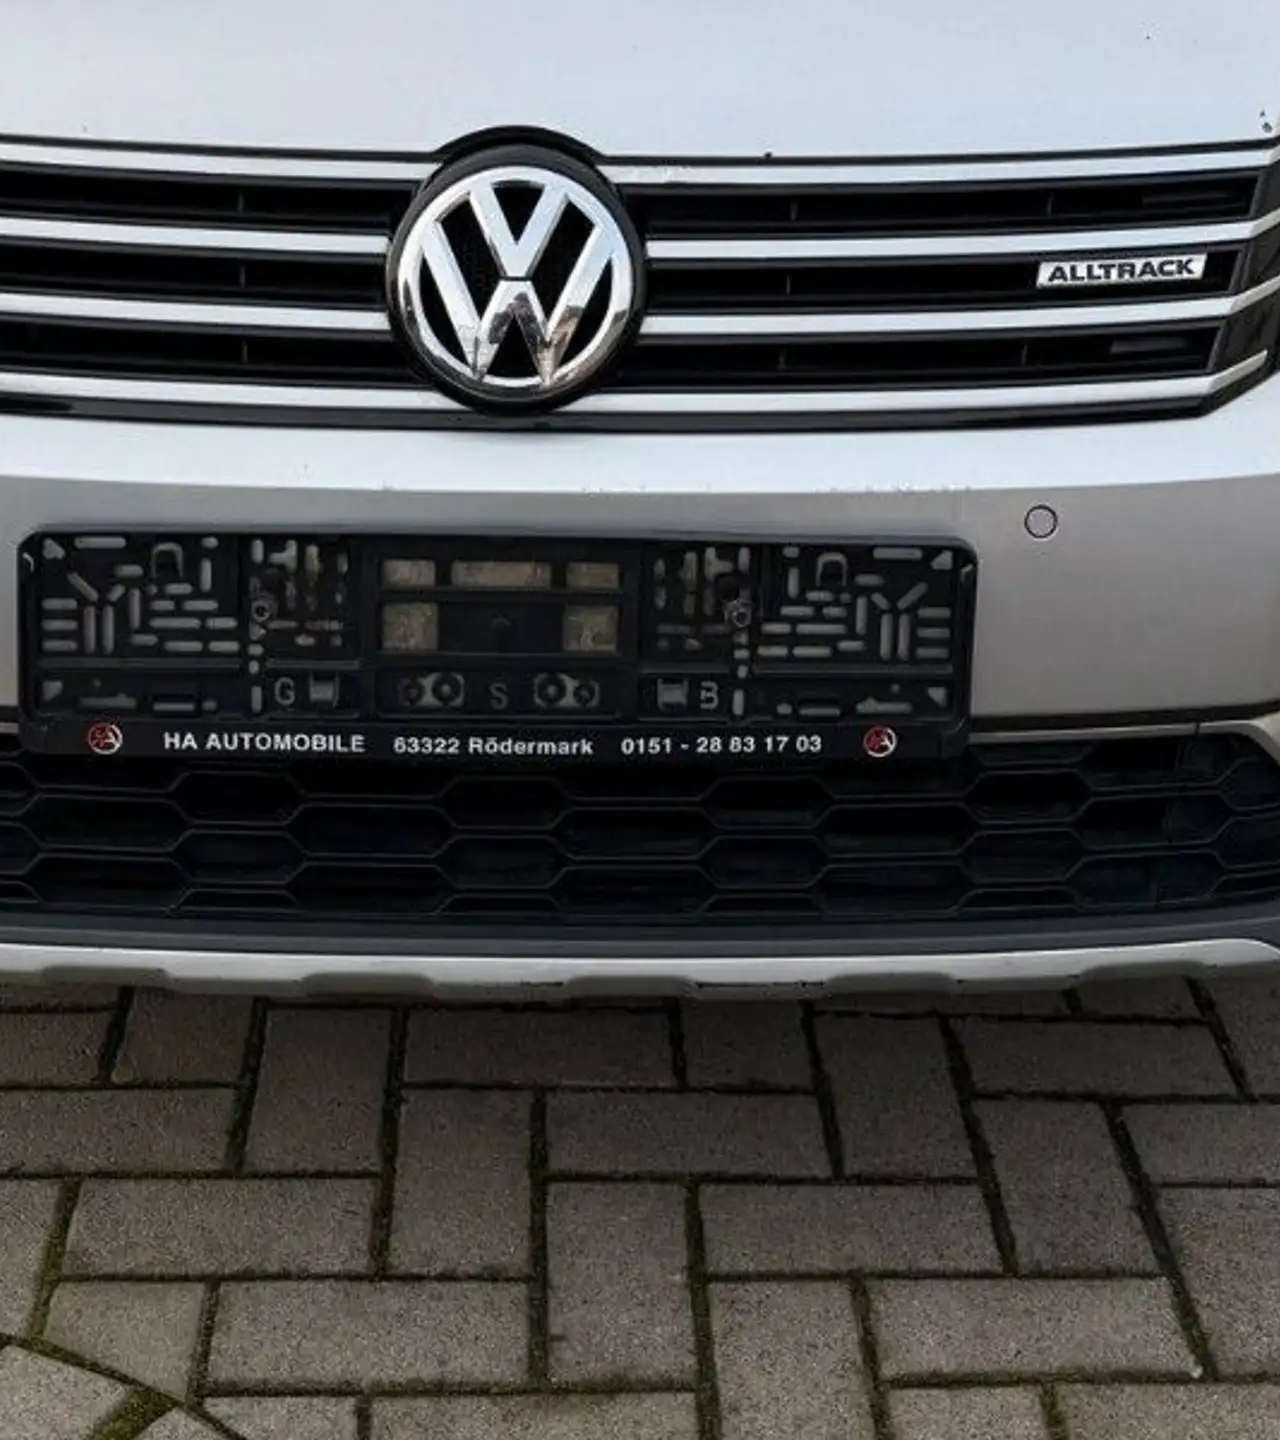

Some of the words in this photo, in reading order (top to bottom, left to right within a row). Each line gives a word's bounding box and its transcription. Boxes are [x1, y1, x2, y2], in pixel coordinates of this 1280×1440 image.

[1048, 258, 1194, 282] ALLTRACK
[163, 731, 198, 752] HA
[205, 732, 366, 753] AUTOMOBILE
[393, 735, 460, 755] 63322
[468, 735, 594, 755] Rödermark
[621, 736, 673, 754] 0151
[696, 735, 721, 753] 28
[729, 735, 756, 753] 83
[764, 735, 789, 753] 17
[796, 735, 822, 753] 03
